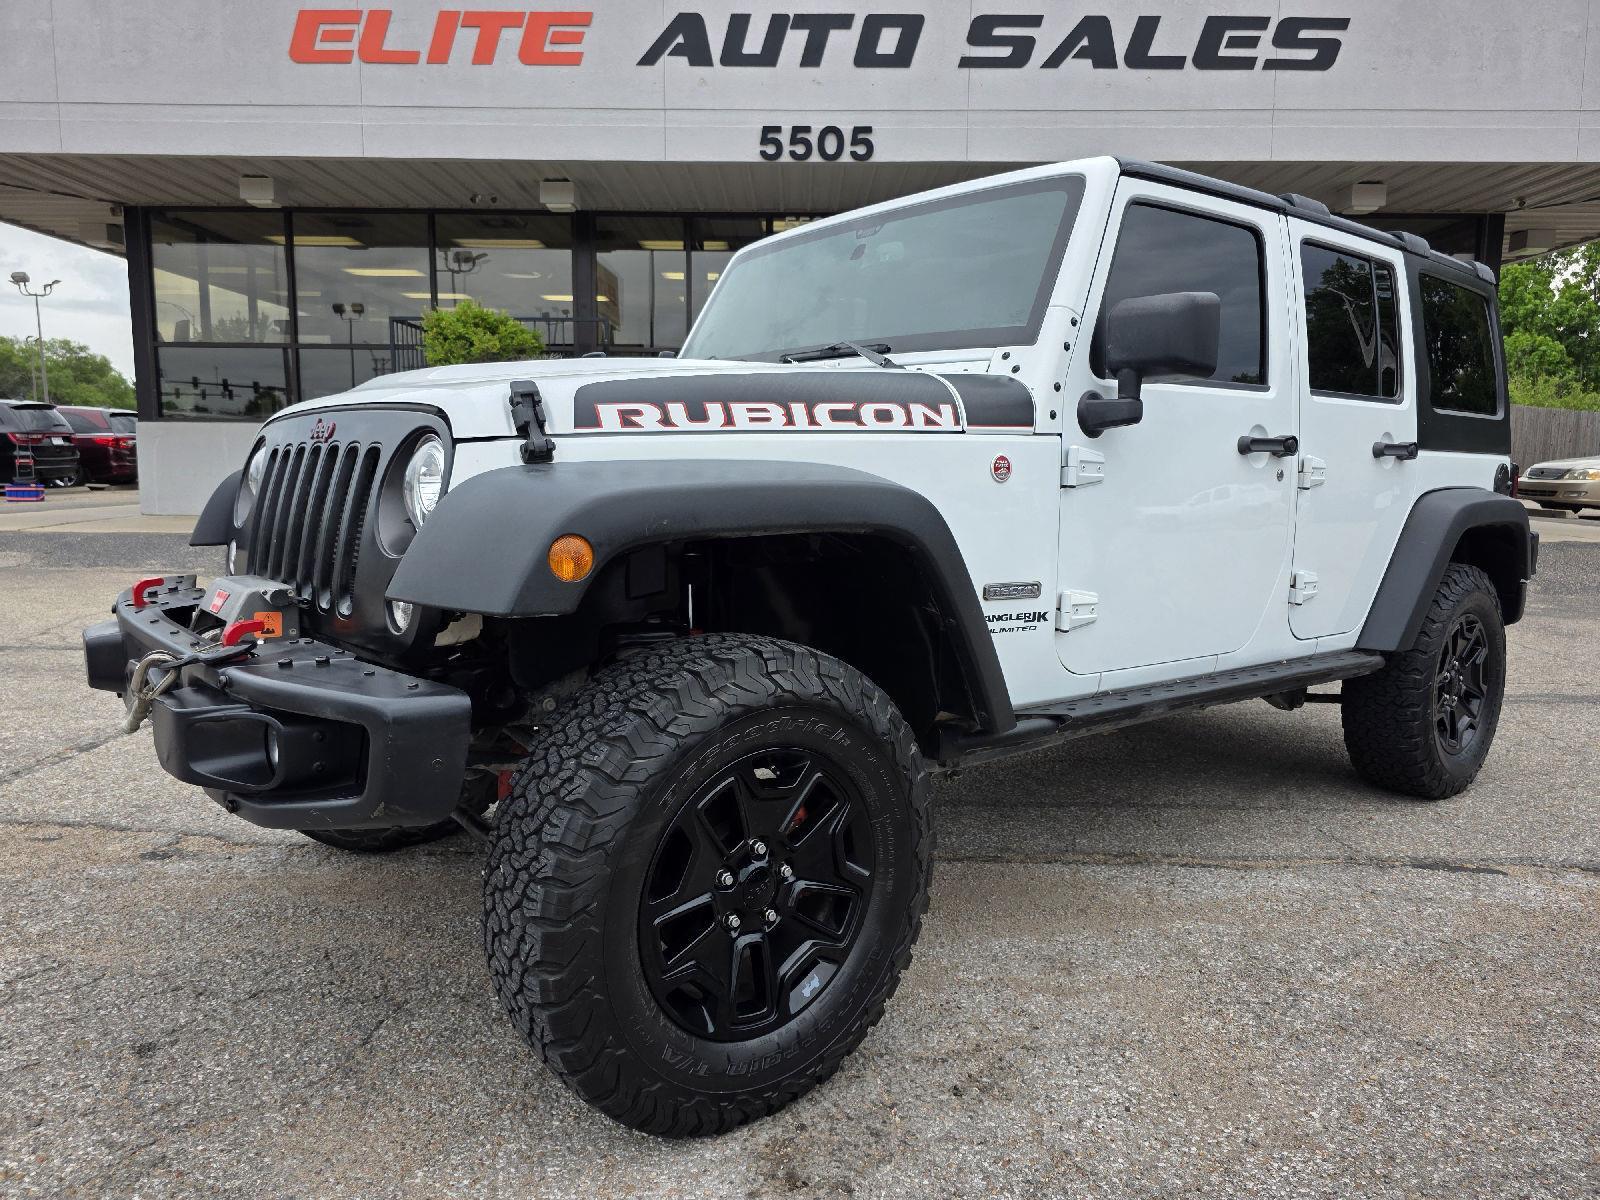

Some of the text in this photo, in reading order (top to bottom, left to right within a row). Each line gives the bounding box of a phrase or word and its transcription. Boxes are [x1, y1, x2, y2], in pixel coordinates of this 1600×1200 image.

[289, 10, 1351, 71] ELITE AUTO SALES
[759, 125, 874, 162] 5505
[594, 401, 962, 430] RUBICON
[984, 611, 1031, 623] ANGLER
